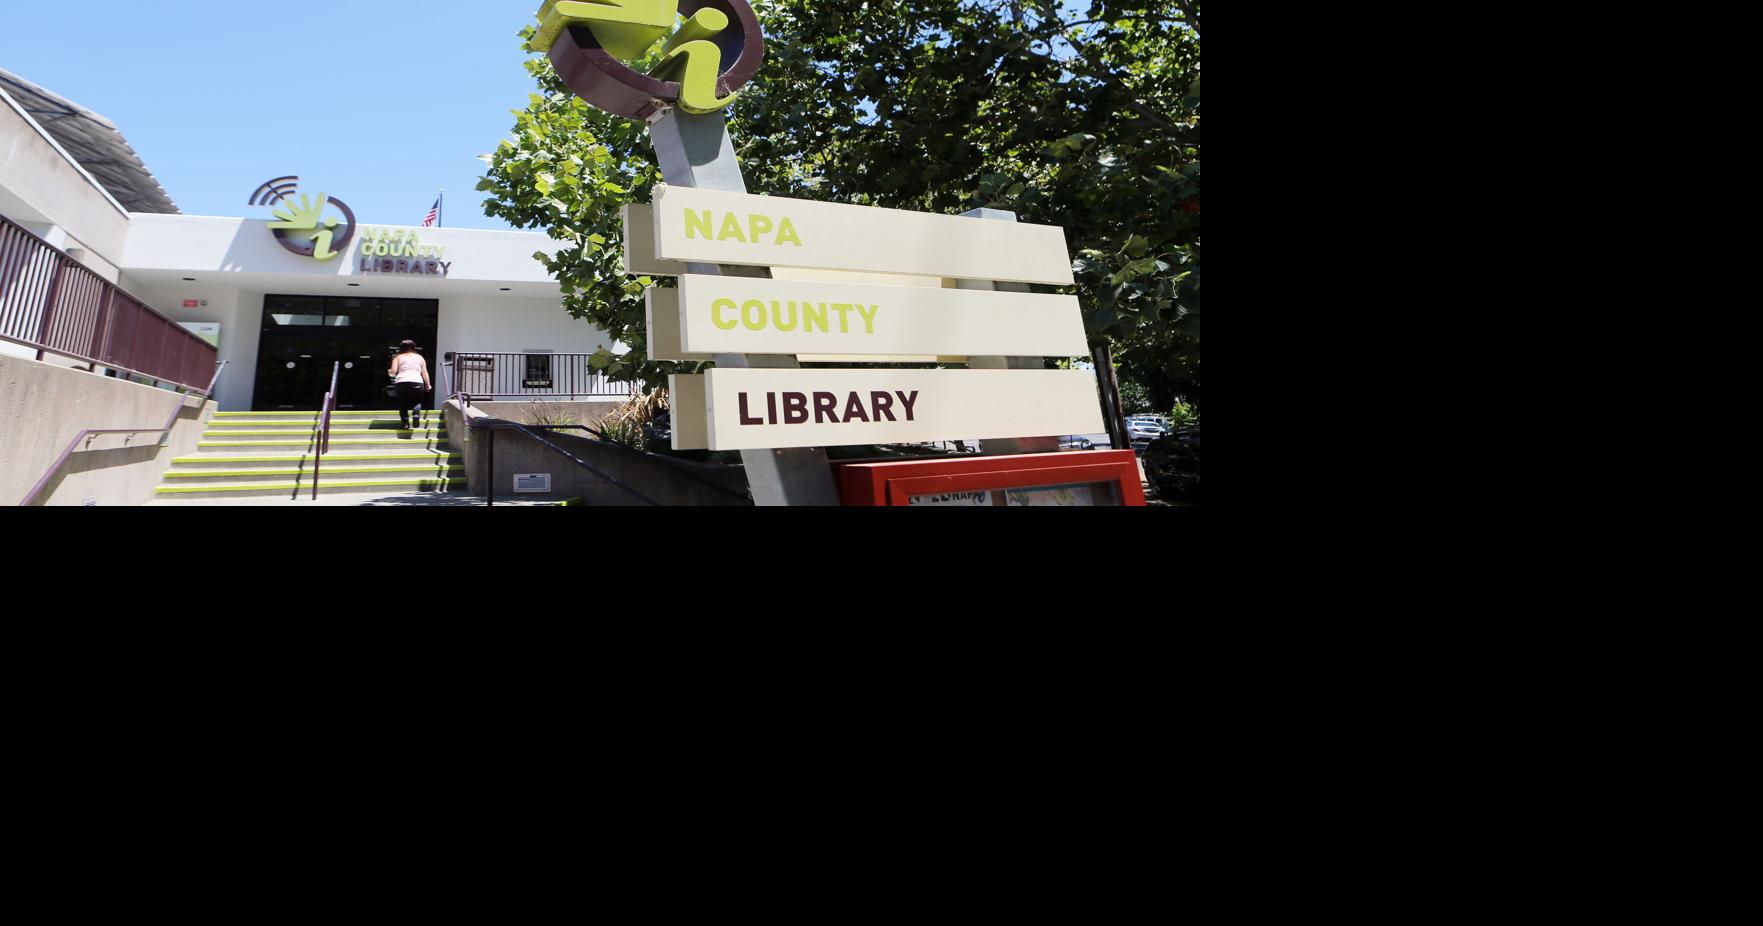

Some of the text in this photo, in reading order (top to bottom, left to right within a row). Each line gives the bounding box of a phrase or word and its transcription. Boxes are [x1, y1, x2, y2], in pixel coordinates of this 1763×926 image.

[363, 227, 418, 243] NAPA
[685, 208, 802, 247] NAPA
[361, 242, 445, 259] COUNTY
[360, 258, 452, 275] LIBRARY
[711, 298, 879, 333] COUNTY
[738, 391, 919, 425] LIBRARY
